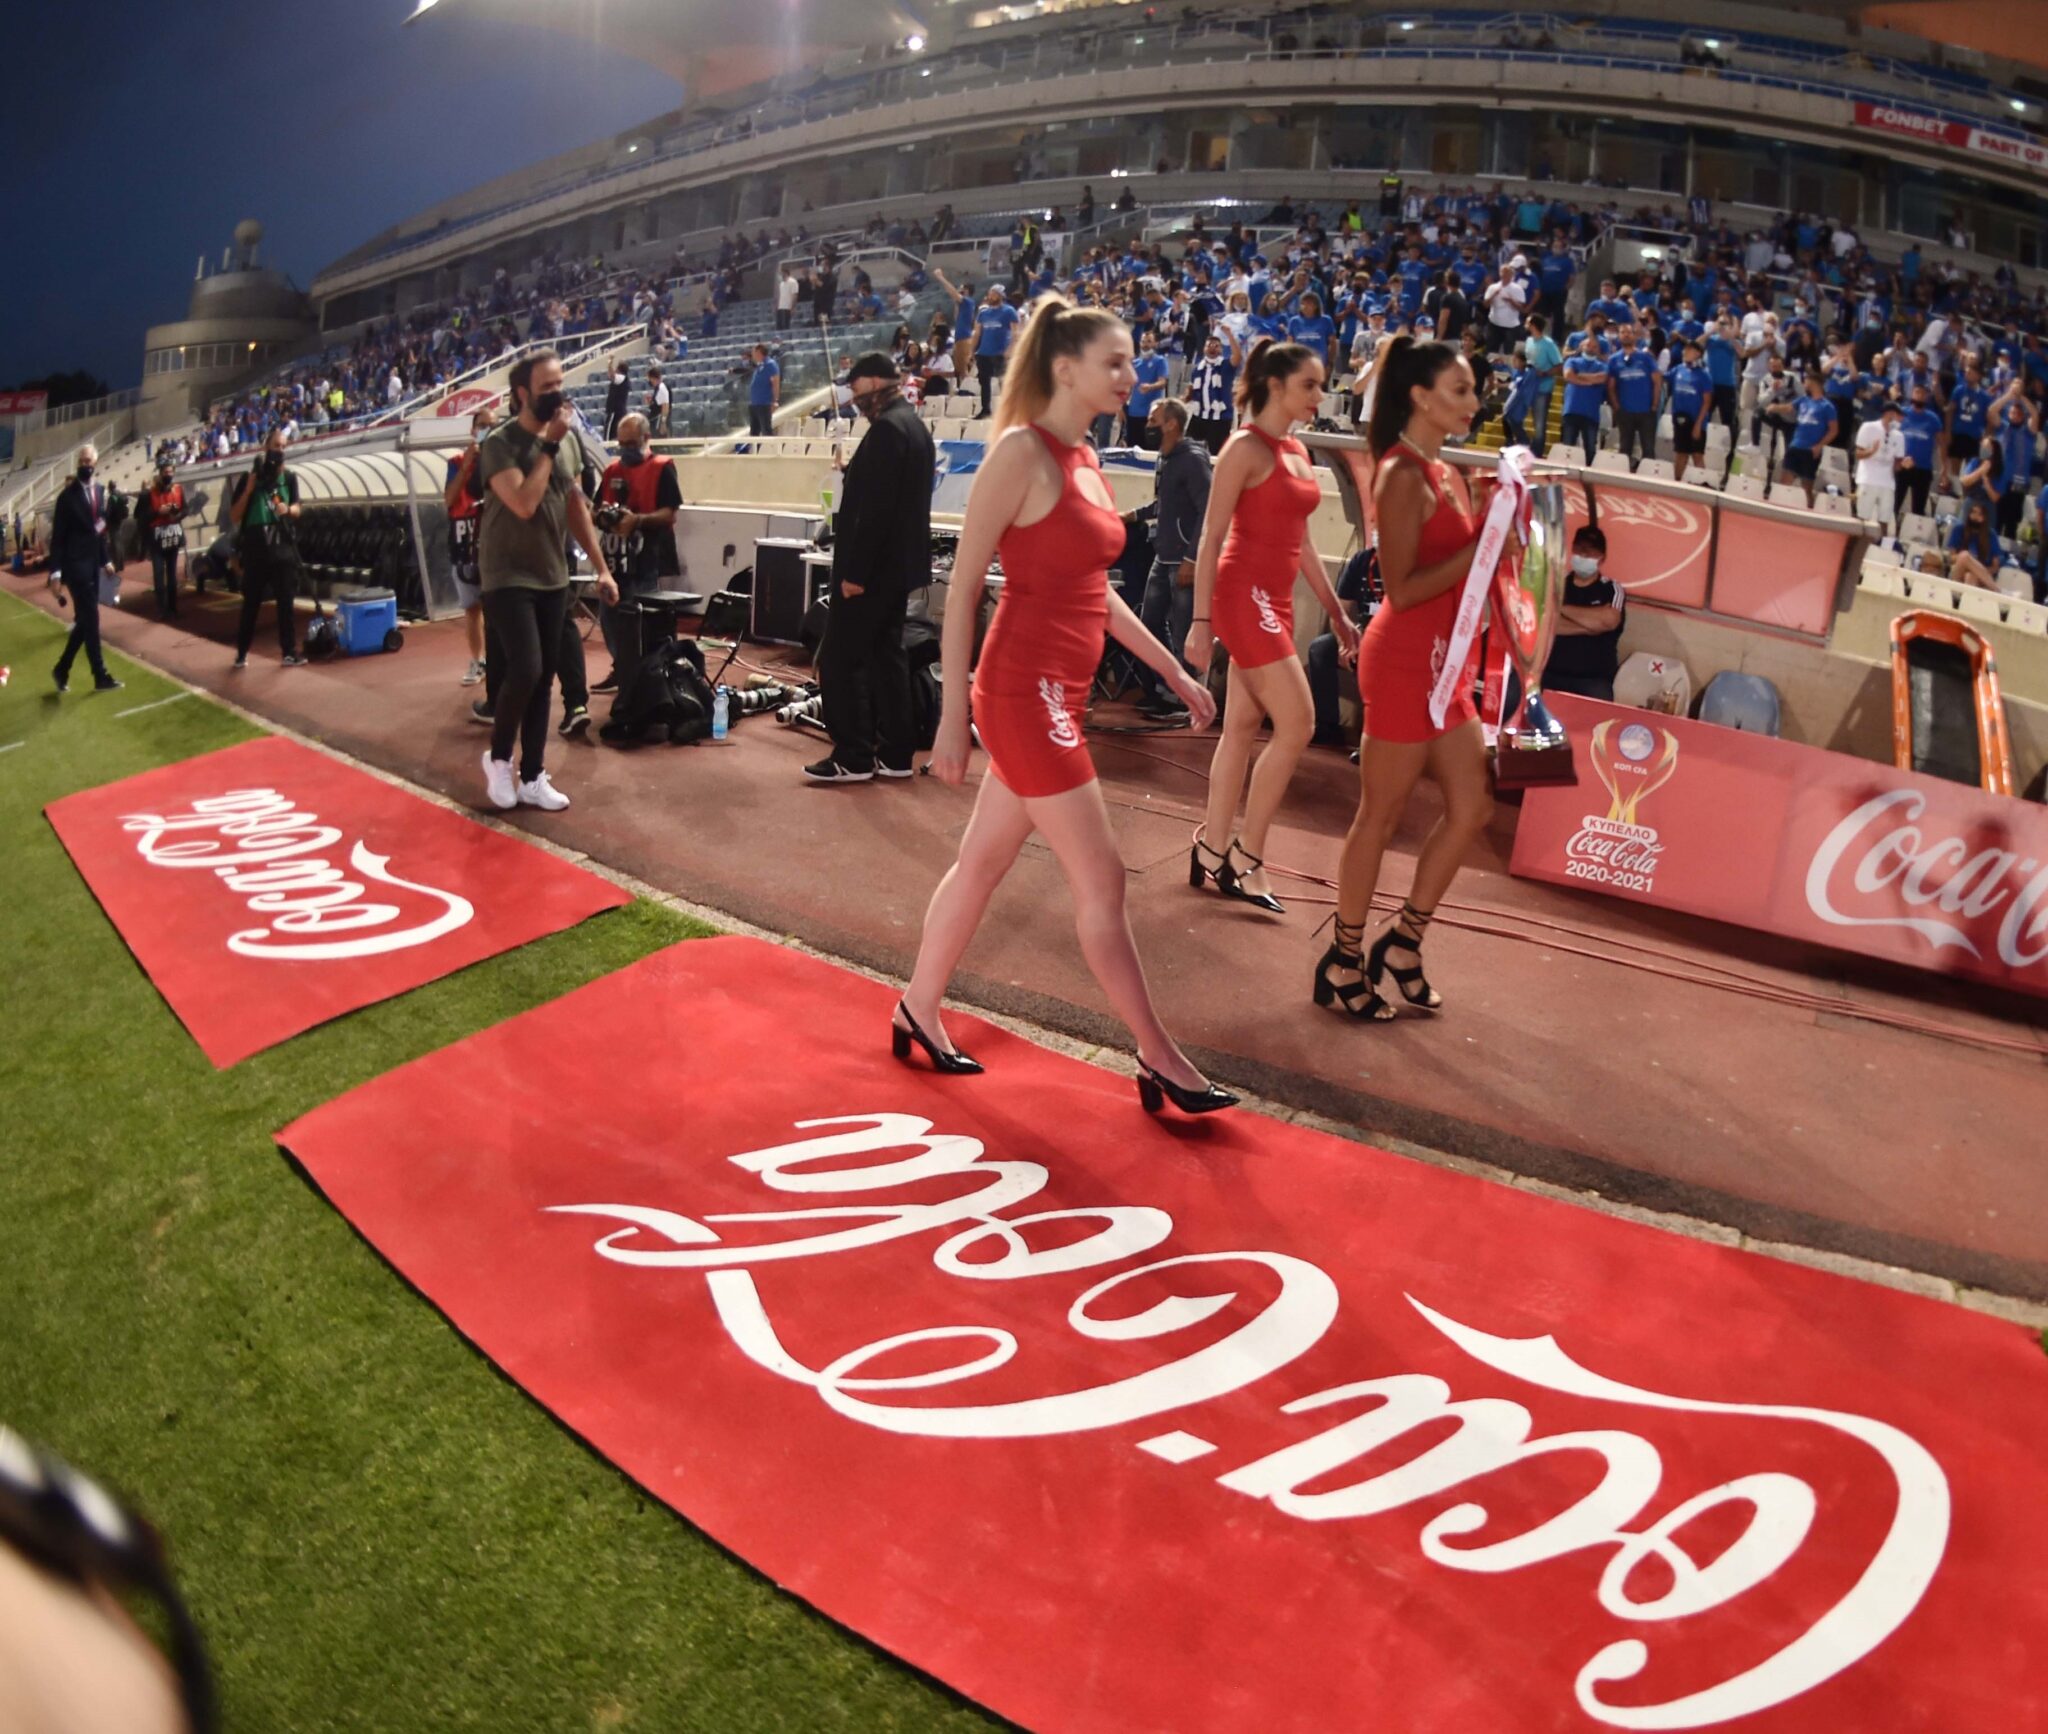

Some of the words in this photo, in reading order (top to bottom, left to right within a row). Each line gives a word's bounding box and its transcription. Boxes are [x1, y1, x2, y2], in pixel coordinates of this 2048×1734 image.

[1872, 107, 1949, 135] FONBET
[1980, 135, 2020, 157] PART
[2024, 148, 2044, 163] OF
[1565, 828, 1666, 875] Coca-Cola
[117, 788, 474, 959] Coca-Cola
[1564, 859, 1654, 893] 2020-2021
[542, 1112, 1951, 1729] Coca-Cola
